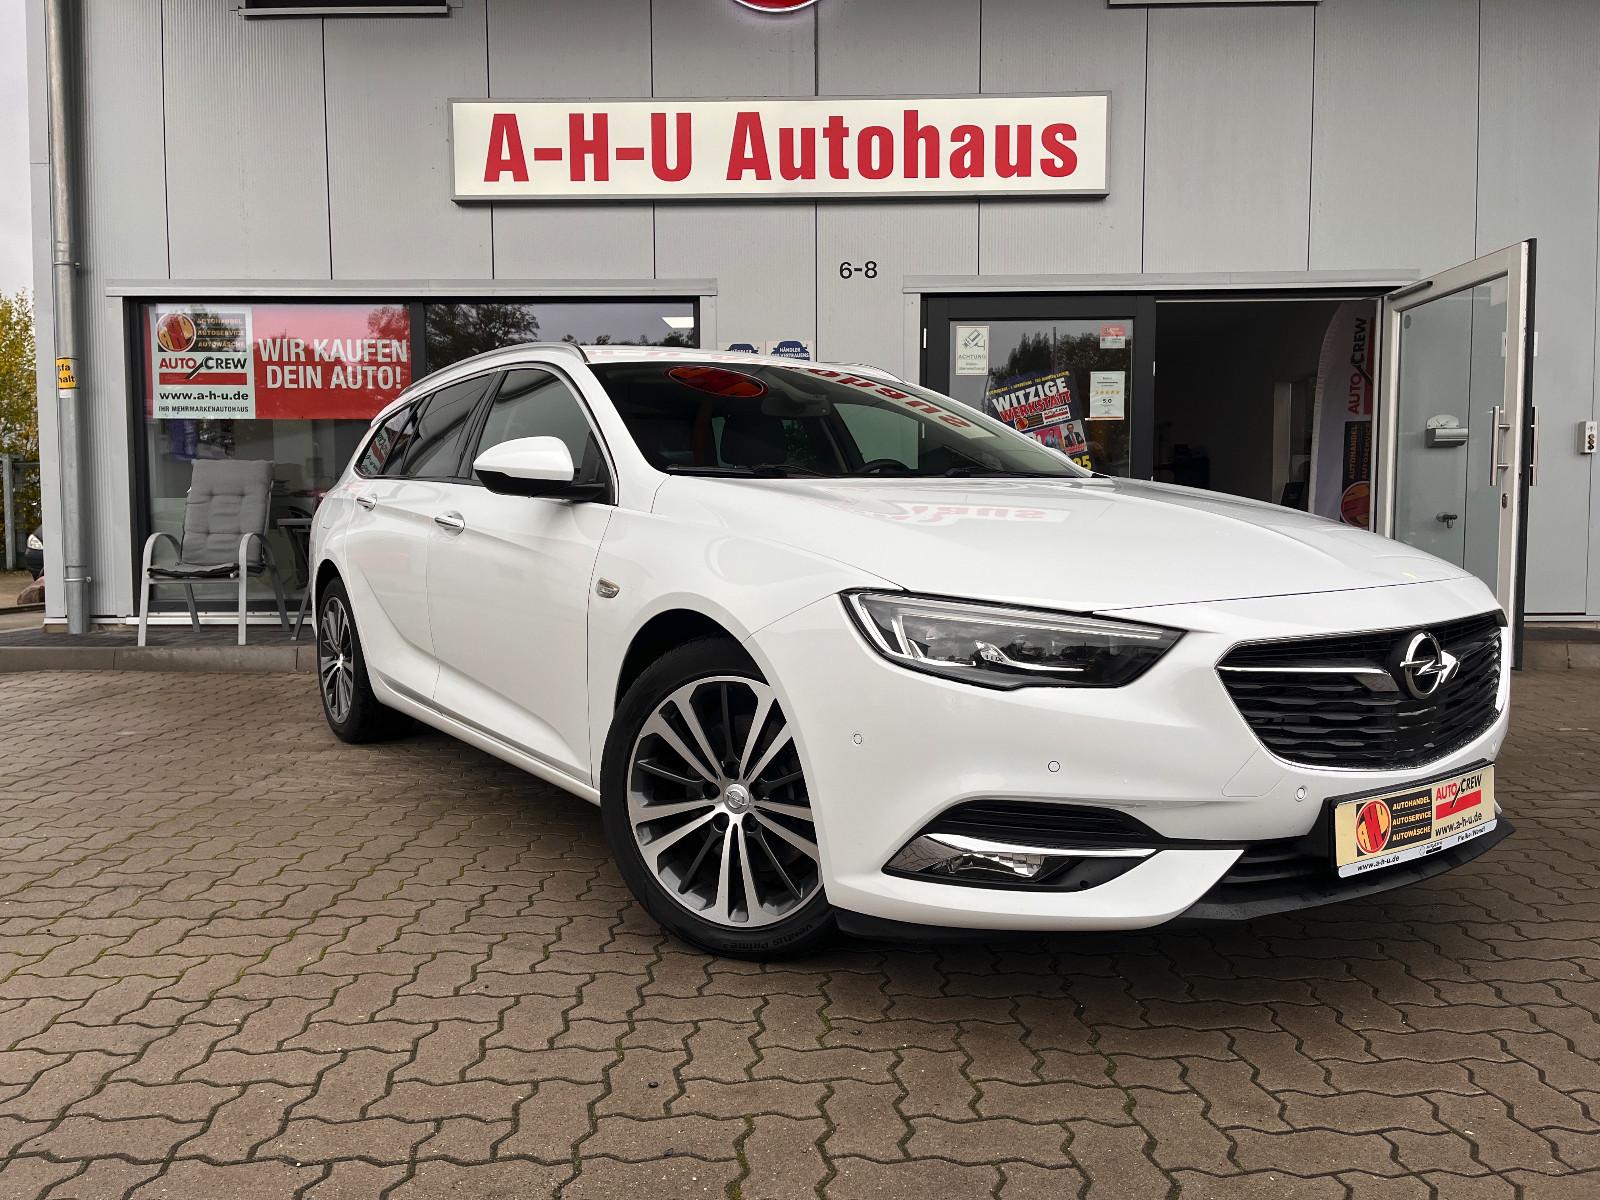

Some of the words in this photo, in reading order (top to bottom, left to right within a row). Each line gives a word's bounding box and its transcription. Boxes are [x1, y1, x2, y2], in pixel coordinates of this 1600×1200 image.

[483, 113, 693, 182] A-H-U
[726, 110, 1078, 180] Autohaus
[838, 261, 879, 279] 6-8
[258, 338, 306, 362] WIR
[313, 338, 408, 363] KAUFEN
[266, 365, 323, 389] DEIN
[330, 365, 402, 390] AUTO!
[159, 390, 249, 401] www.a-h-u.de
[991, 376, 1069, 415] WITZIGE
[999, 389, 1072, 423] WERKSTATT
[171, 405, 249, 413] MEHRMARKENAUTOHAUS
[1435, 782, 1457, 801] AUTO
[1460, 774, 1482, 795] CREW
[1392, 796, 1430, 811] AUTOHANDEL
[1392, 811, 1432, 826] AUTOSERVICE
[1435, 811, 1482, 837] www.a-h-u.de
[1392, 825, 1431, 841] AUTOWÄSCHE
[1357, 855, 1400, 871] www.a-h-u.de
